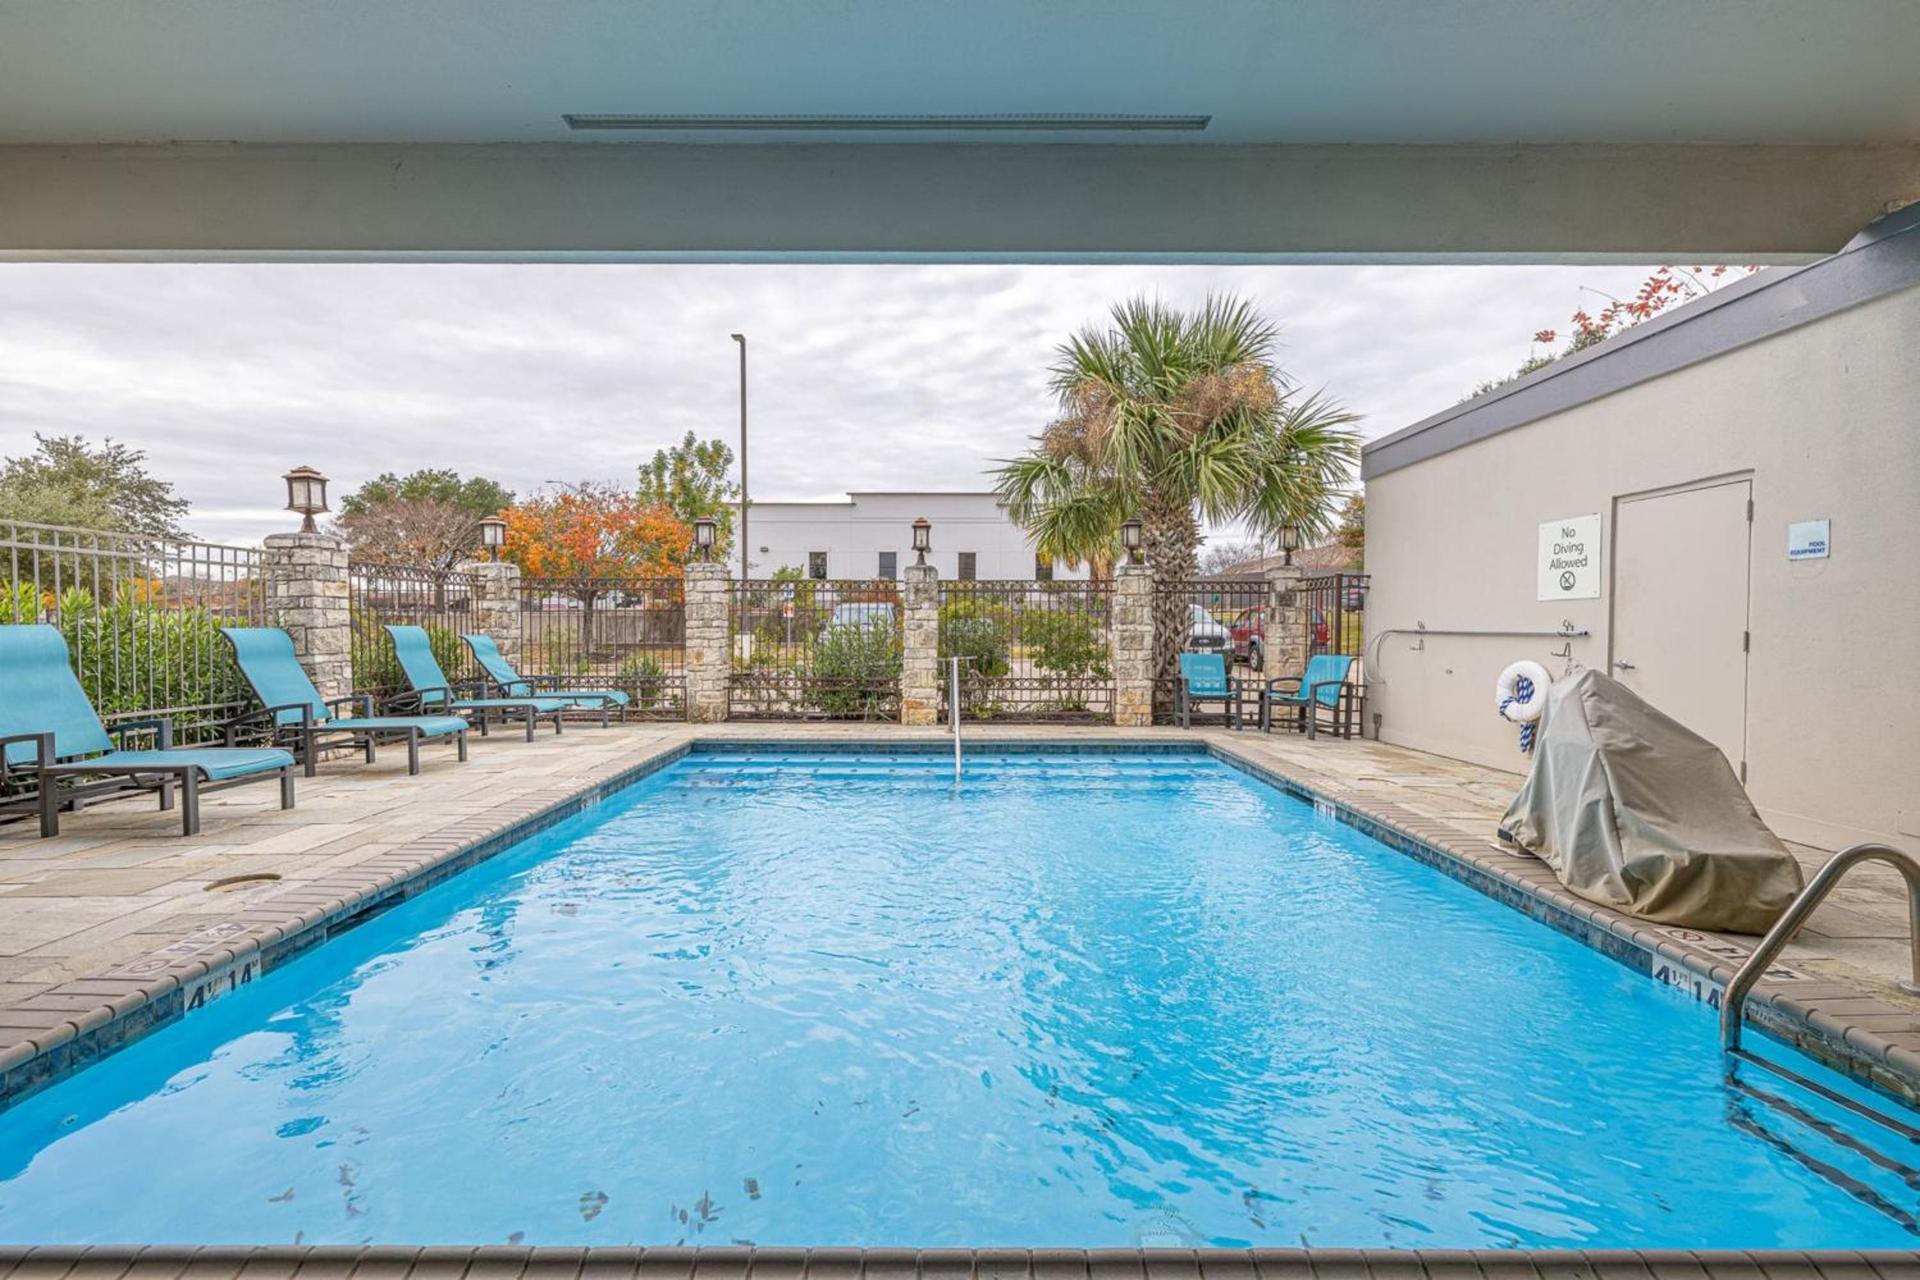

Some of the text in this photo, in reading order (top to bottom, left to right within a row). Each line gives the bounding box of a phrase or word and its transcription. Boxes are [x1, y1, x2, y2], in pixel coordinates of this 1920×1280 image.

[1561, 527, 1576, 538] No
[1553, 542, 1584, 555] Diving
[1790, 547, 1826, 555] EQUIPMENT
[1549, 555, 1588, 570] Allowed
